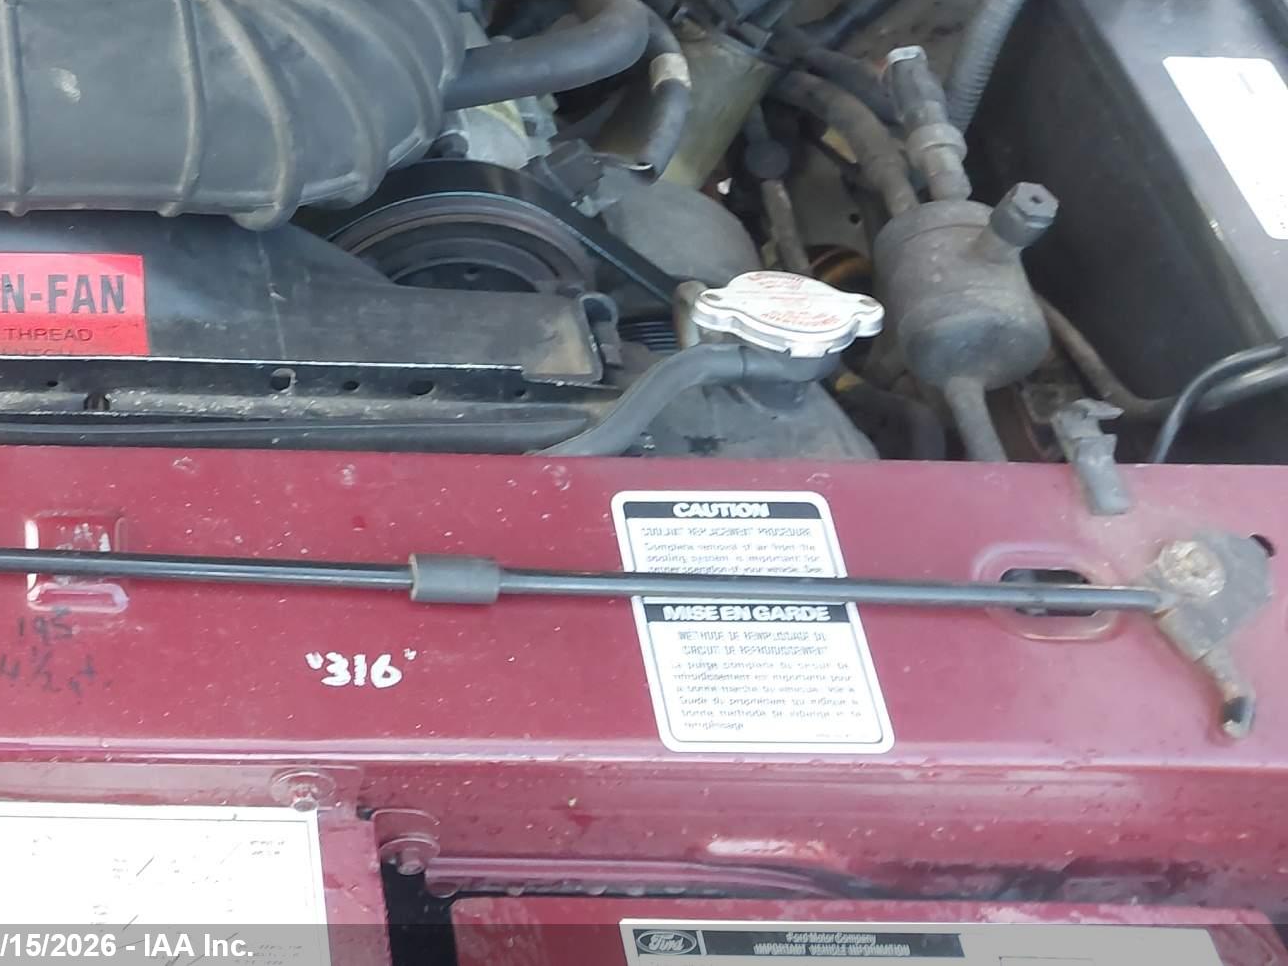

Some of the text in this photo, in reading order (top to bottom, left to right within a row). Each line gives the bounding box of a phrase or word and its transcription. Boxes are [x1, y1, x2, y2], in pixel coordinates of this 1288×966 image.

[4, 328, 94, 342] THREAD
[672, 502, 770, 518] CAUTION
[663, 605, 831, 621] MISE EN GARDE
[648, 933, 685, 952] Ford
[785, 931, 876, 946] Ford Motor Company
[753, 943, 910, 957] IMPORTANT VEHICLE INFORMATION
